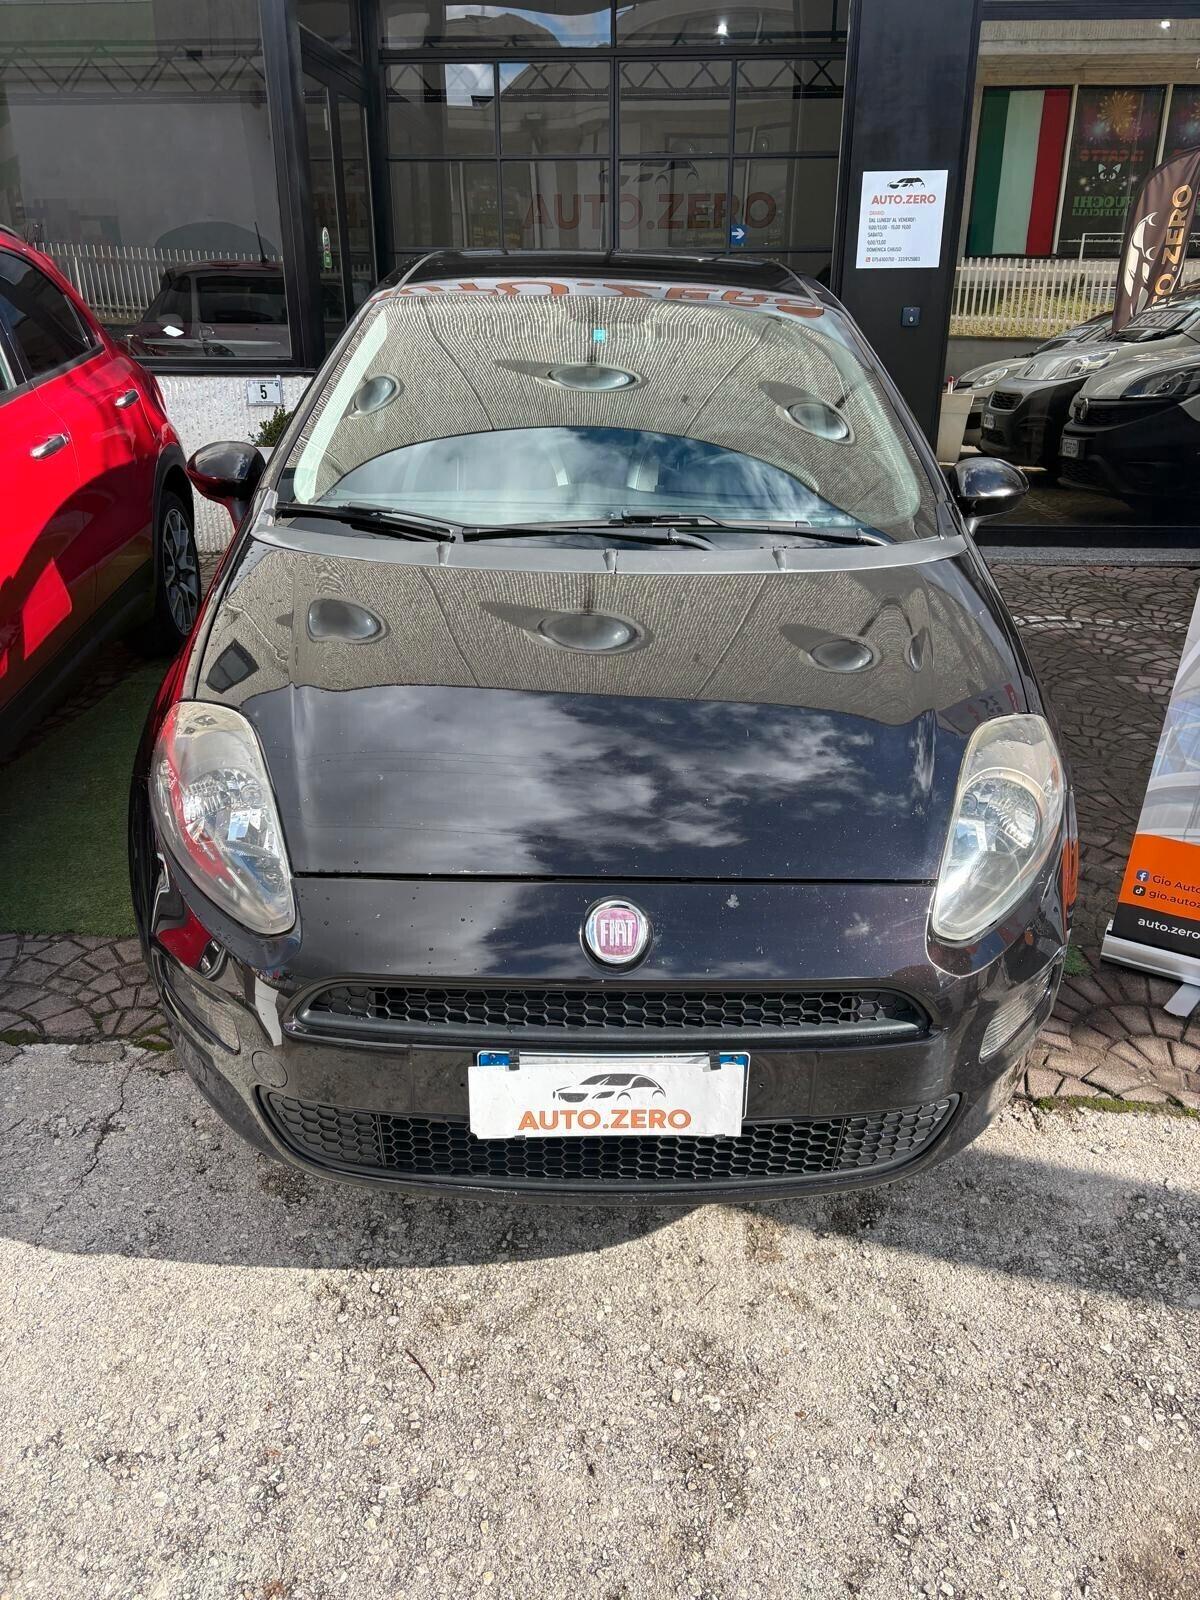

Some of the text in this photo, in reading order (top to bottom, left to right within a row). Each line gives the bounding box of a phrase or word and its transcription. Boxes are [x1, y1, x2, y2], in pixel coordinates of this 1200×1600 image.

[871, 194, 936, 205] AUTO.ZERO
[522, 192, 777, 230] AUTO.ZERO
[1152, 184, 1192, 304] O.ZERO
[260, 384, 268, 400] 5
[1152, 875, 1172, 887] Gio
[600, 919, 636, 947] FIAT
[1138, 917, 1200, 940] auto.zero
[518, 1109, 692, 1131] AUTO.ZERO
